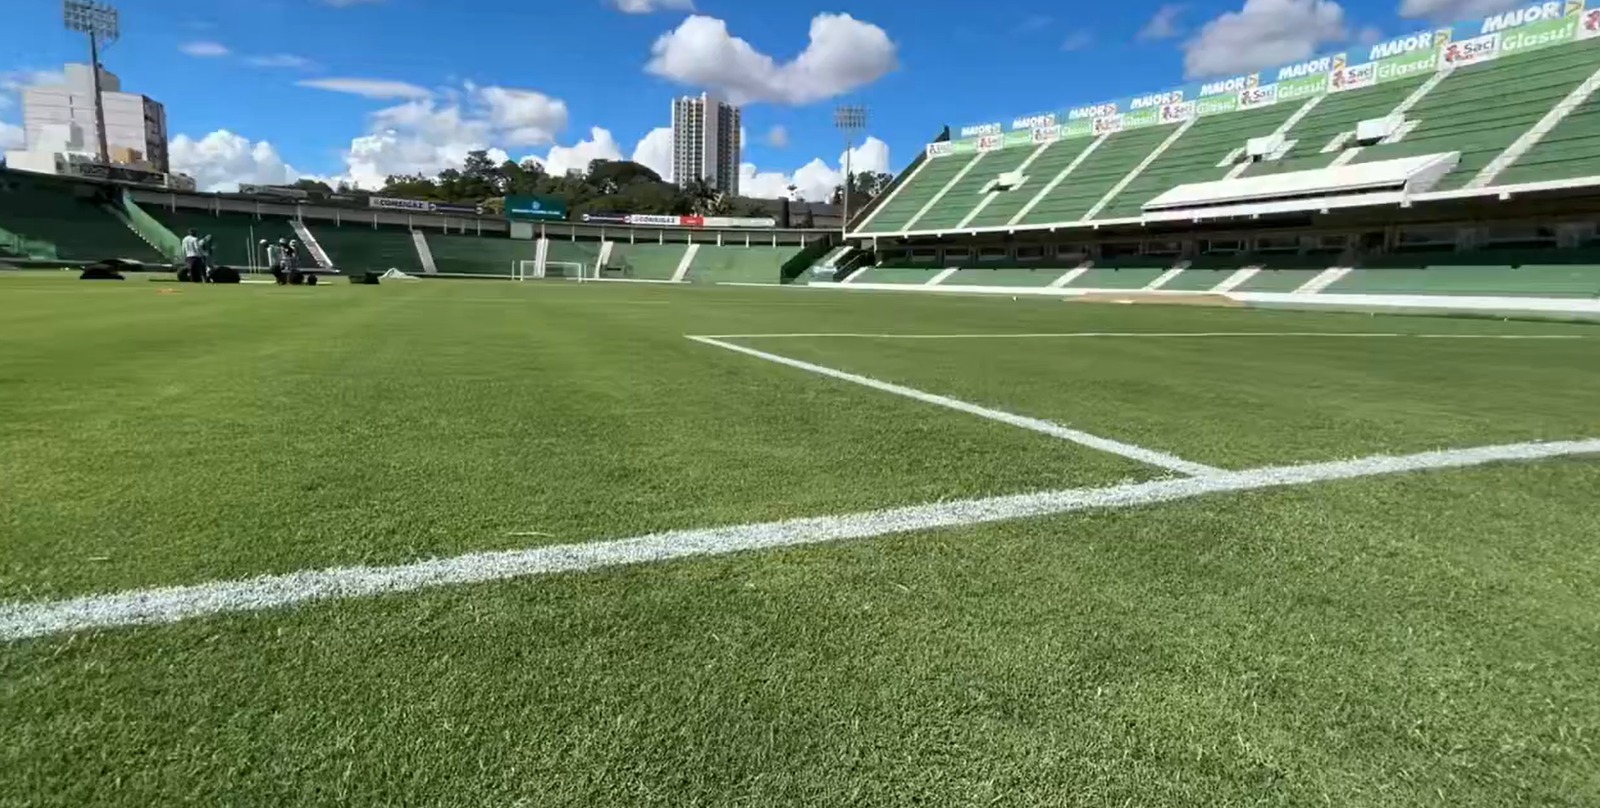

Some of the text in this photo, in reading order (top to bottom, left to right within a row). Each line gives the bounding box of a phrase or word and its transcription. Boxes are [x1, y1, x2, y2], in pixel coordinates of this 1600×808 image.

[1481, 1, 1560, 33] MAIOR
[1369, 32, 1433, 60] MAIOR
[1463, 36, 1495, 54] Saci
[1502, 22, 1574, 50] Glasu!
[1278, 56, 1331, 80] MAIOR
[1379, 54, 1436, 78] Glasu!
[1200, 77, 1245, 96] MAIOR
[1069, 105, 1105, 119] MAIOR
[1130, 92, 1170, 110] MAIOR
